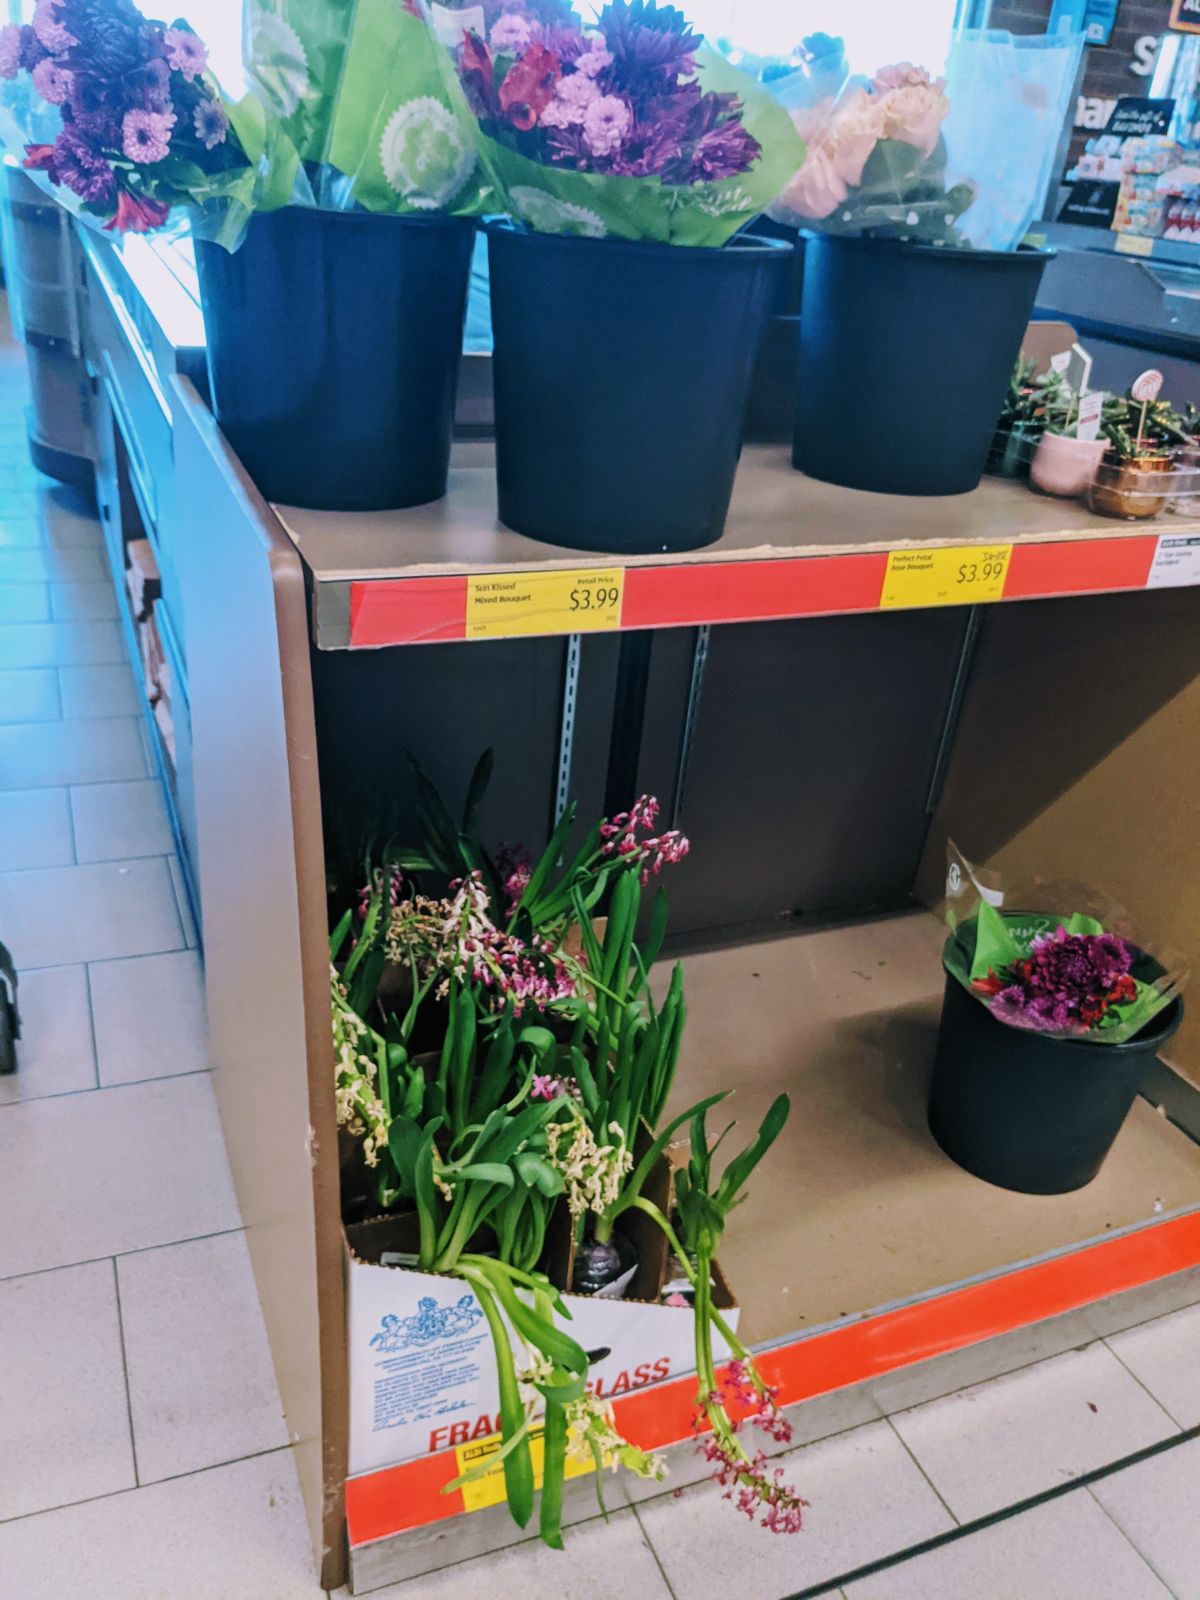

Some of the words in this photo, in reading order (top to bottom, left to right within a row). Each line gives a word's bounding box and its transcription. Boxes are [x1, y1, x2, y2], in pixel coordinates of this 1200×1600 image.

[892, 554, 915, 562] Perfect
[915, 553, 933, 561] Petal
[906, 563, 934, 571] Bouquet
[956, 562, 1003, 584] $3.99
[597, 576, 614, 584] Price
[475, 584, 490, 592] Sun
[492, 582, 516, 591] Kissed
[474, 595, 498, 604] Mixed
[499, 594, 531, 603] Bouquet
[569, 587, 619, 612] $3.99
